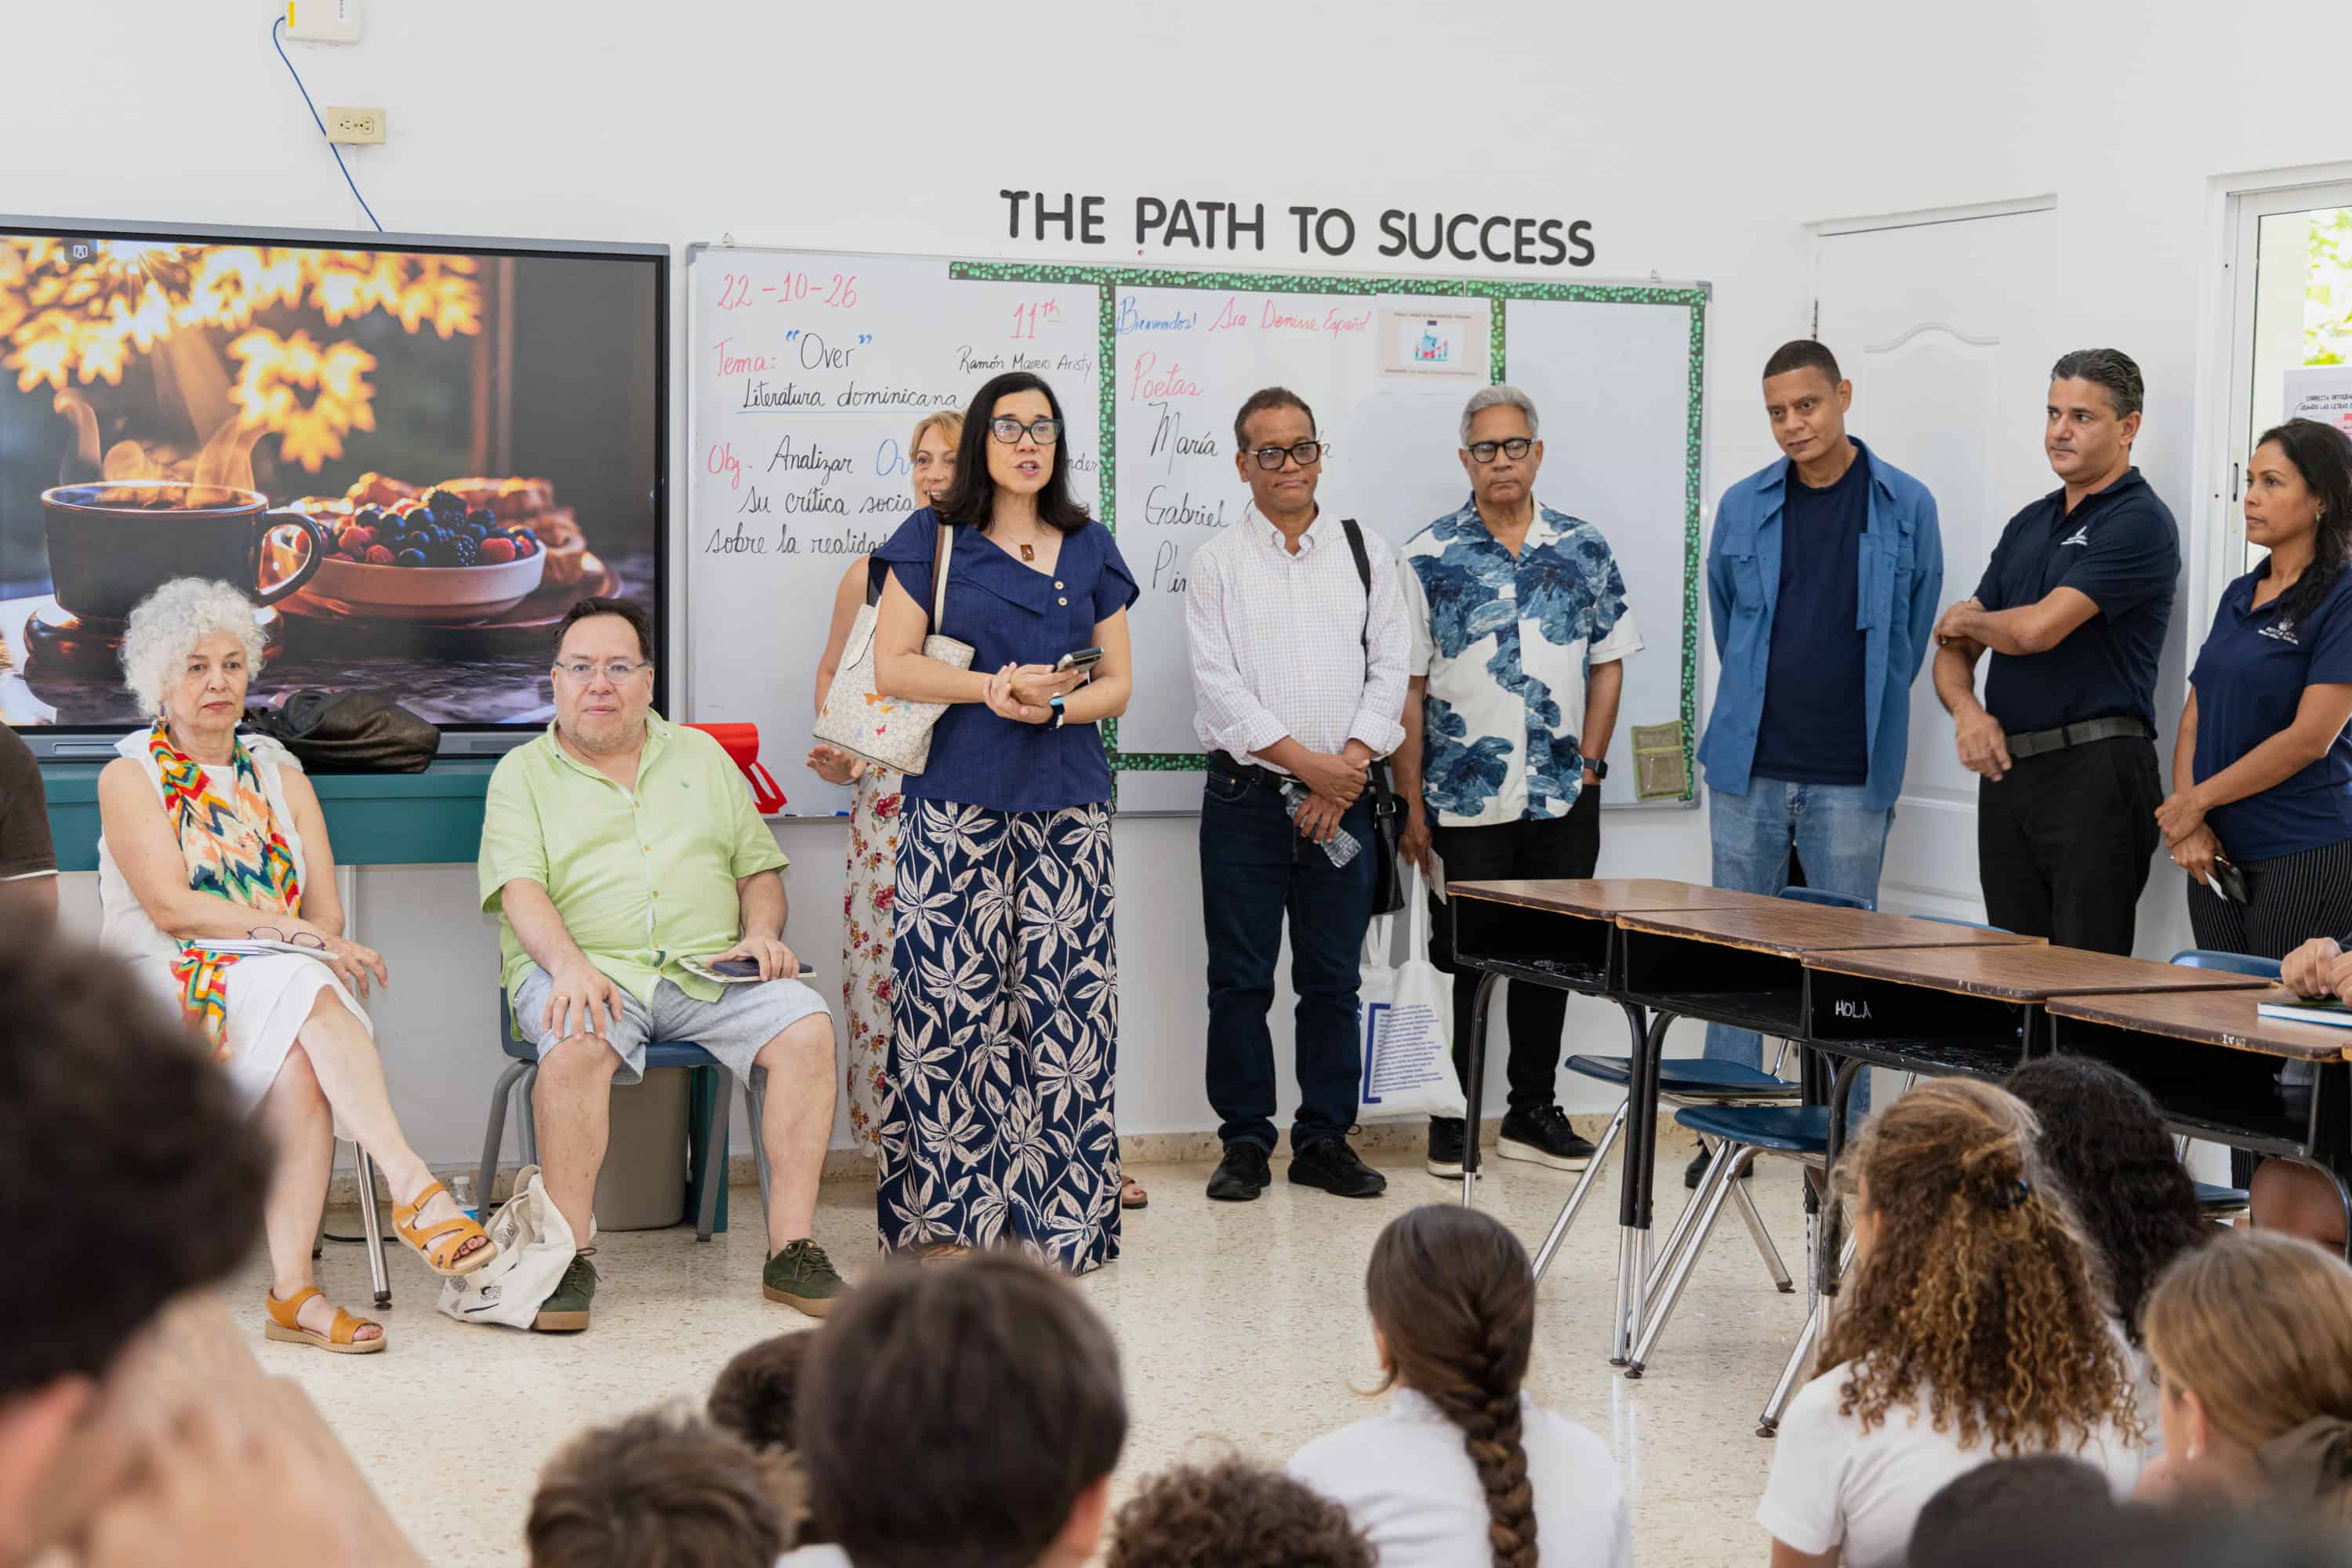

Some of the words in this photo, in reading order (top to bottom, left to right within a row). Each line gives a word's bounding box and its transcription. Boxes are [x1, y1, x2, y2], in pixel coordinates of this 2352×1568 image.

[1000, 189, 1105, 245] THE
[1135, 197, 1264, 251] PATH
[1288, 206, 1356, 256] TO
[1377, 209, 1595, 267] SUCCESS
[714, 337, 777, 376] Tema:
[956, 345, 1004, 374] Ramón
[1057, 352, 1092, 383] Aristy
[1131, 351, 1204, 401] Poetas
[743, 378, 826, 408] Literatura
[837, 381, 966, 409] dominicana
[1148, 401, 1218, 476] María
[767, 434, 854, 485] Analizar
[785, 487, 851, 515] crítica
[859, 494, 916, 514] socia
[1145, 485, 1230, 528] Gabriel
[775, 523, 800, 554] la
[1835, 999, 1872, 1019] HOLA
